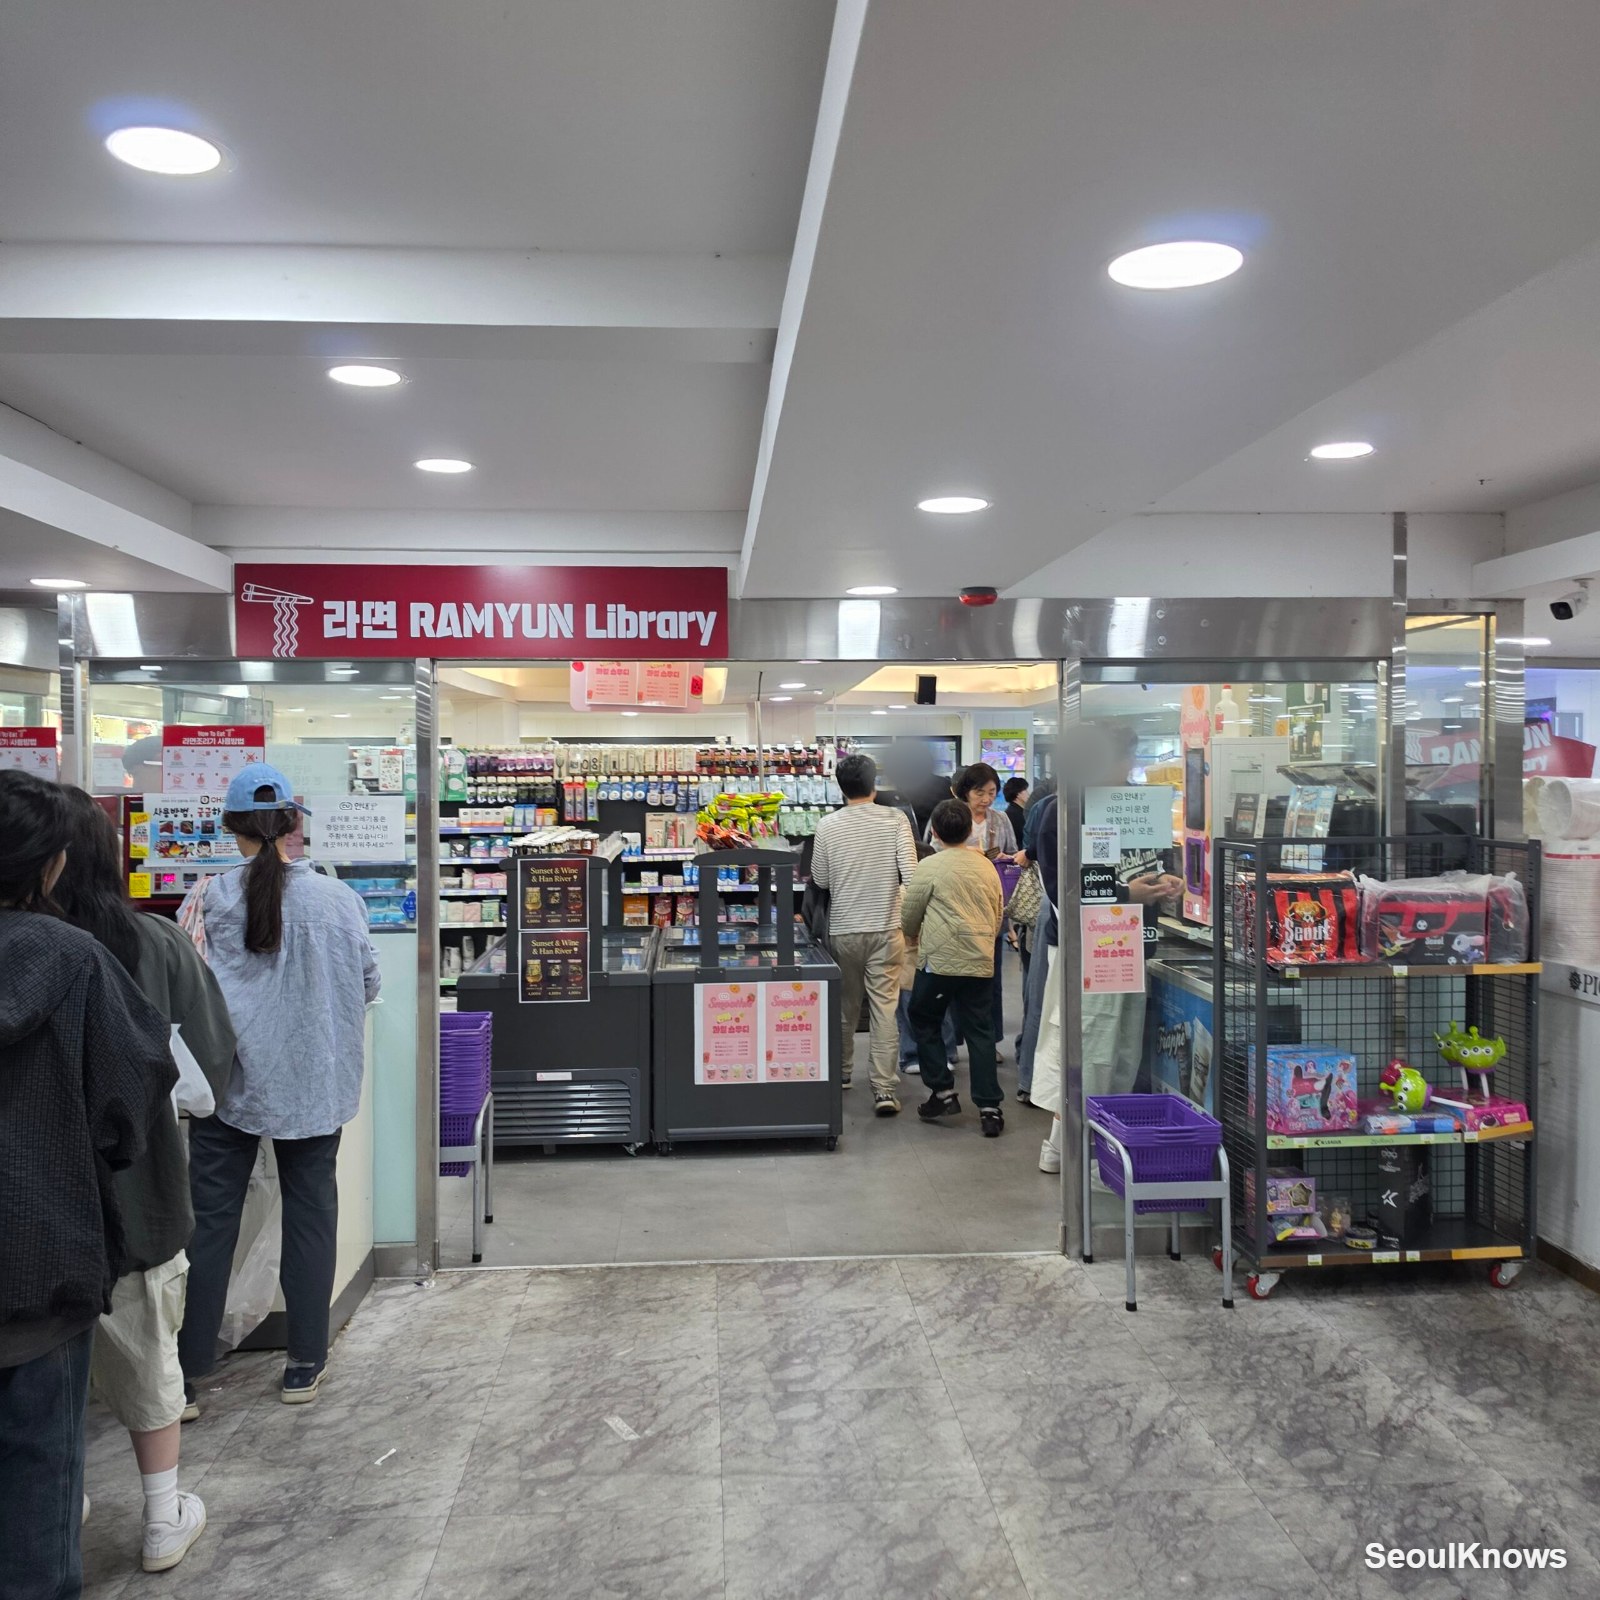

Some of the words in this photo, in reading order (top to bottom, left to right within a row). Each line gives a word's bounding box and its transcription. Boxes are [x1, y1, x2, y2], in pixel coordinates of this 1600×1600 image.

[323, 600, 398, 639] 라면
[410, 602, 574, 639] RAMYUN
[585, 603, 718, 646] Library
[530, 867, 554, 875] Sunset
[554, 867, 560, 875] &
[561, 866, 579, 874] Wine
[1084, 870, 1113, 887] ploom
[531, 939, 555, 947] Sunset
[561, 939, 579, 947] Wine
[555, 947, 572, 955] River
[1583, 973, 1600, 997] PI
